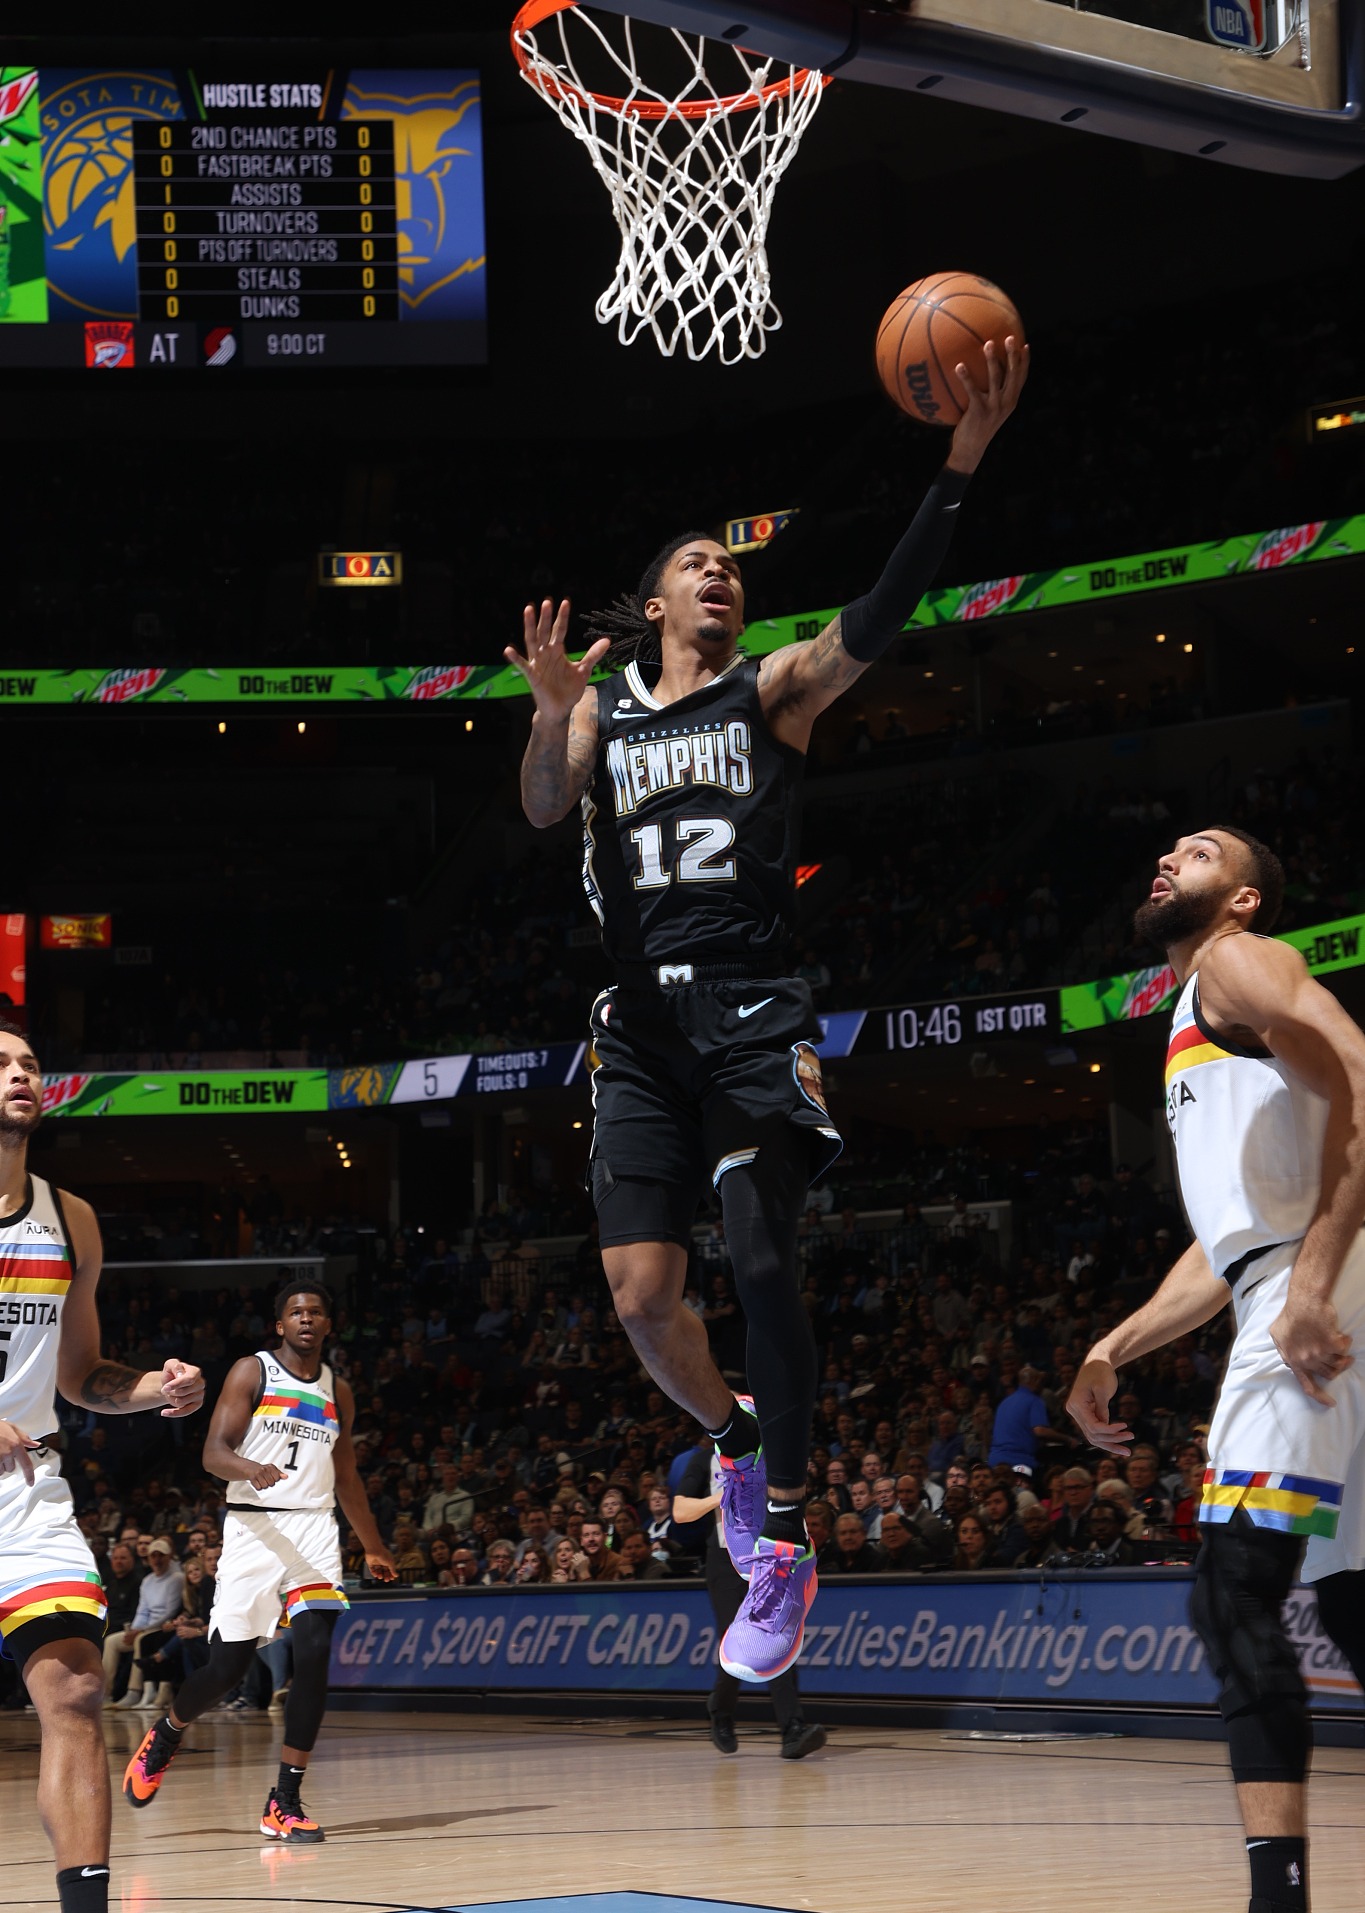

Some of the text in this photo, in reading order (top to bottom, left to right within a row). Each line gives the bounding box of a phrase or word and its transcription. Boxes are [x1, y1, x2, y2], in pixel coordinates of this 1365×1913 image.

[1215, 6, 1244, 36] NBA
[203, 84, 322, 108] HUSTLE STATS
[159, 126, 370, 149] 0 2ND CHANCE PTS 0
[161, 155, 371, 178] 0 FASTBREAK PTS 0
[231, 183, 302, 205] ASSISTS
[360, 183, 372, 205] 0
[163, 211, 373, 233] 0 TURNOVERS 0
[164, 239, 374, 262] 0 PTS OFF TURNOVERS 0
[166, 267, 375, 290] 0 STEALS 0
[167, 295, 375, 318] 0 DUNKS 0
[150, 333, 179, 363] AT
[266, 334, 326, 354] 9:00 CT
[627, 722, 722, 742] GRIZZLIES
[606, 719, 753, 816] MEMPHIS
[630, 815, 737, 890] 12
[886, 1004, 962, 1050] 10:46
[1010, 1003, 1047, 1029] QTR
[477, 1050, 548, 1073] TIMEOUTS: 7
[423, 1062, 438, 1097] 5
[477, 1072, 527, 1093] FOULS: 0
[263, 1420, 331, 1446] MINNESOTA
[284, 1441, 300, 1471] 1
[340, 1618, 404, 1665] GET
[398, 1618, 425, 1665] A
[422, 1611, 505, 1671] $200
[507, 1614, 591, 1665] GIFT
[587, 1613, 690, 1665] CARD
[798, 1609, 1202, 1687] zzliesBanking.com
